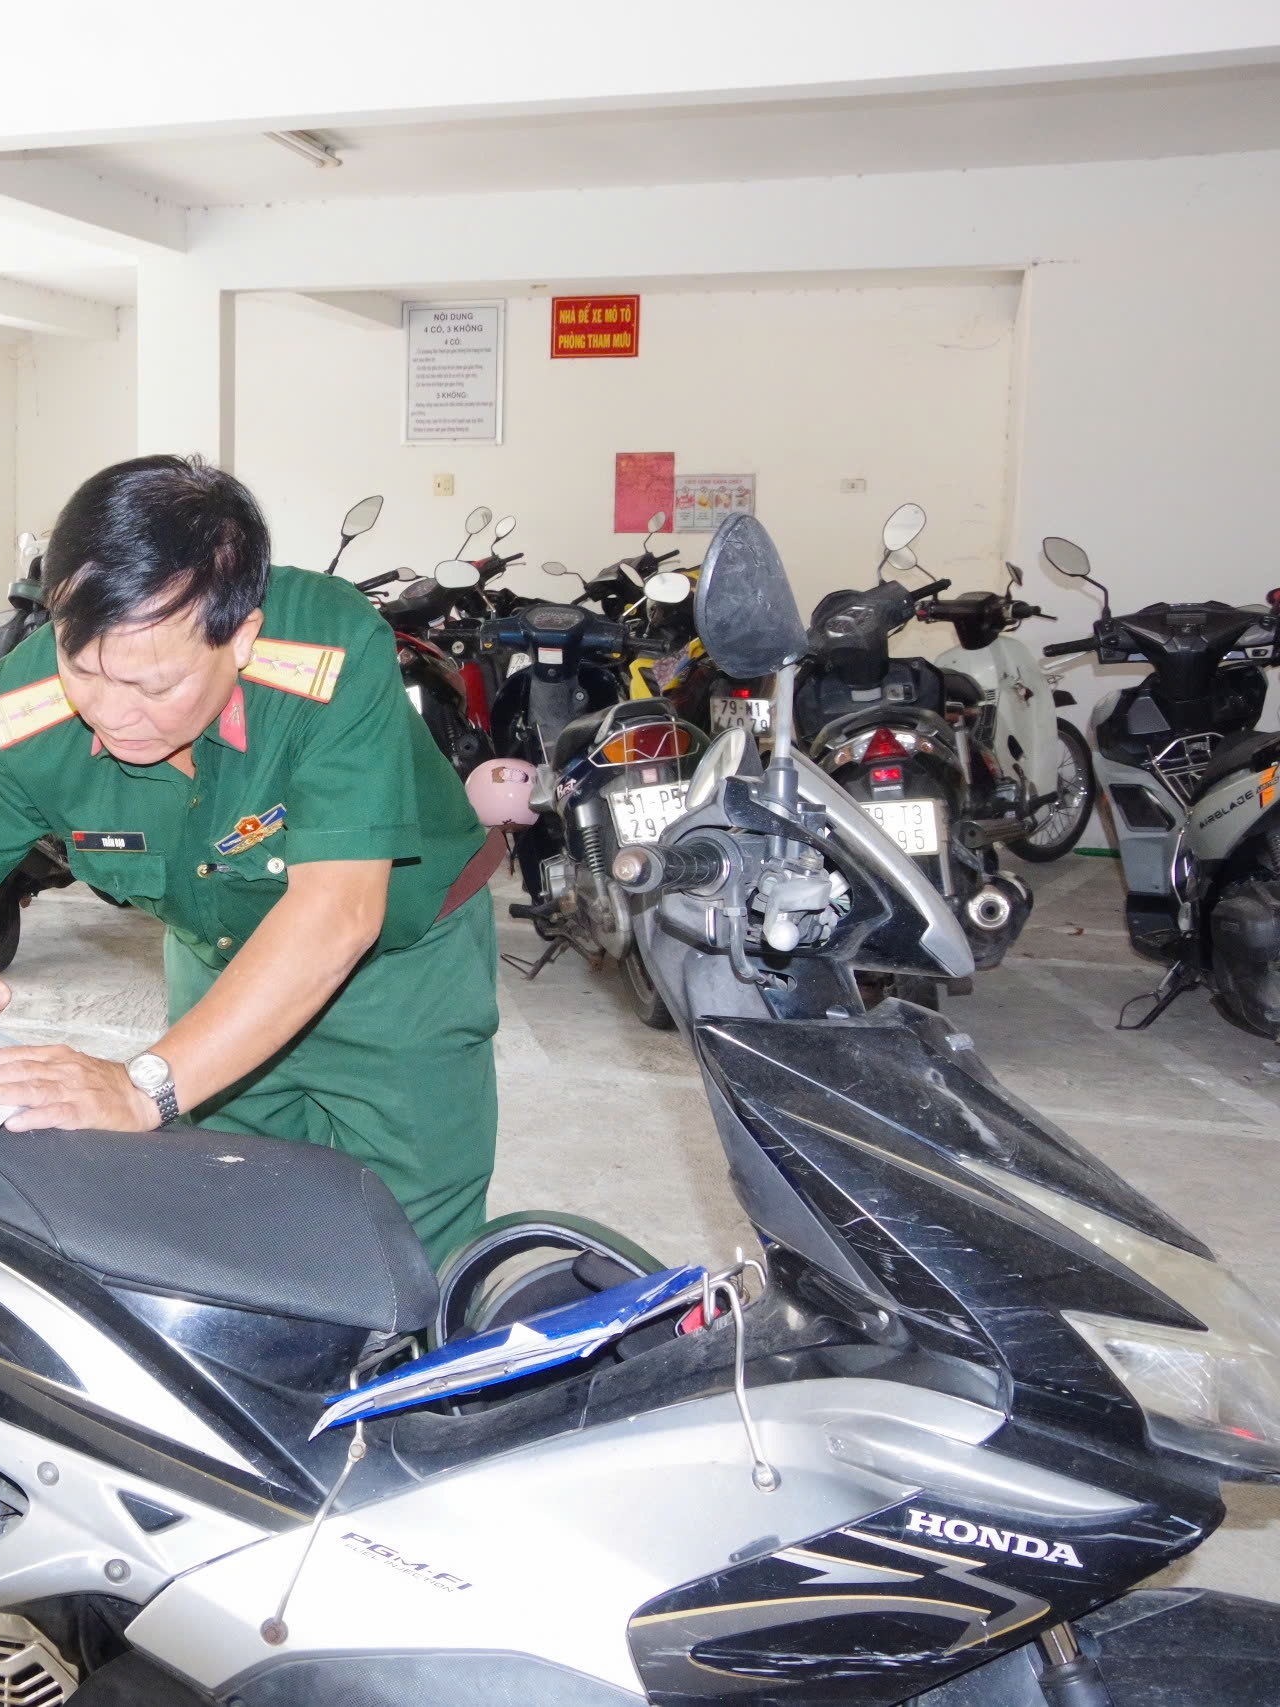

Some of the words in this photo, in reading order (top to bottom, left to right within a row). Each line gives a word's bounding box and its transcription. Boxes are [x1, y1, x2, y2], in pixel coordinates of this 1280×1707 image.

[433, 312, 448, 322] NỘI
[450, 312, 473, 320] DUNG
[559, 305, 576, 324] NHÀ
[578, 302, 591, 324] ĐỂ
[592, 308, 602, 323] XE
[604, 304, 618, 323] MÔ
[620, 304, 631, 322] TÔ
[453, 323, 483, 332] KHÔNG
[558, 331, 586, 349] PHÒNG
[587, 333, 611, 349] THAM
[906, 1508, 1084, 1568] HONDA
[340, 1532, 473, 1591] PGM-FI
